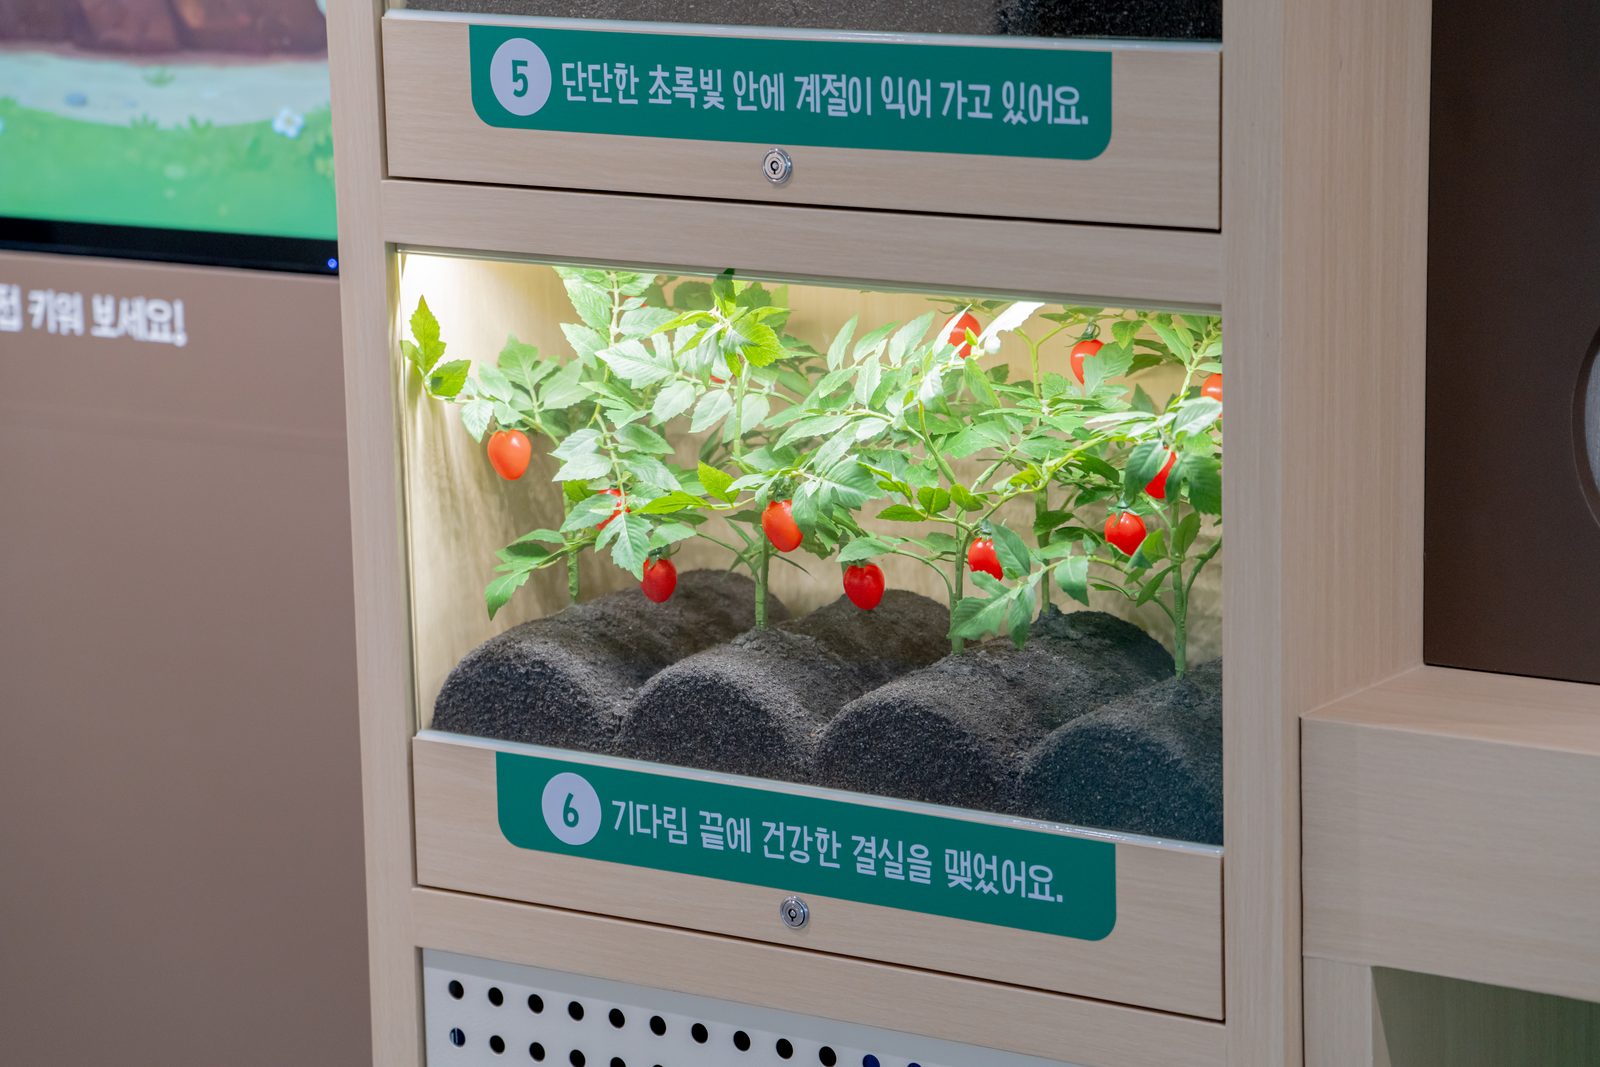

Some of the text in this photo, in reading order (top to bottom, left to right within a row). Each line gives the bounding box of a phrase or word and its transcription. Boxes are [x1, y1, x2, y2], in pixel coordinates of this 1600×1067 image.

[511, 59, 1089, 125] 5 단단한 초록빛 안에 계절이 익어 가고 있어요.
[90, 293, 188, 347] 보세요!
[562, 792, 1063, 903] 6 기다림 끝에 건강한 결실을 맺었어요.
